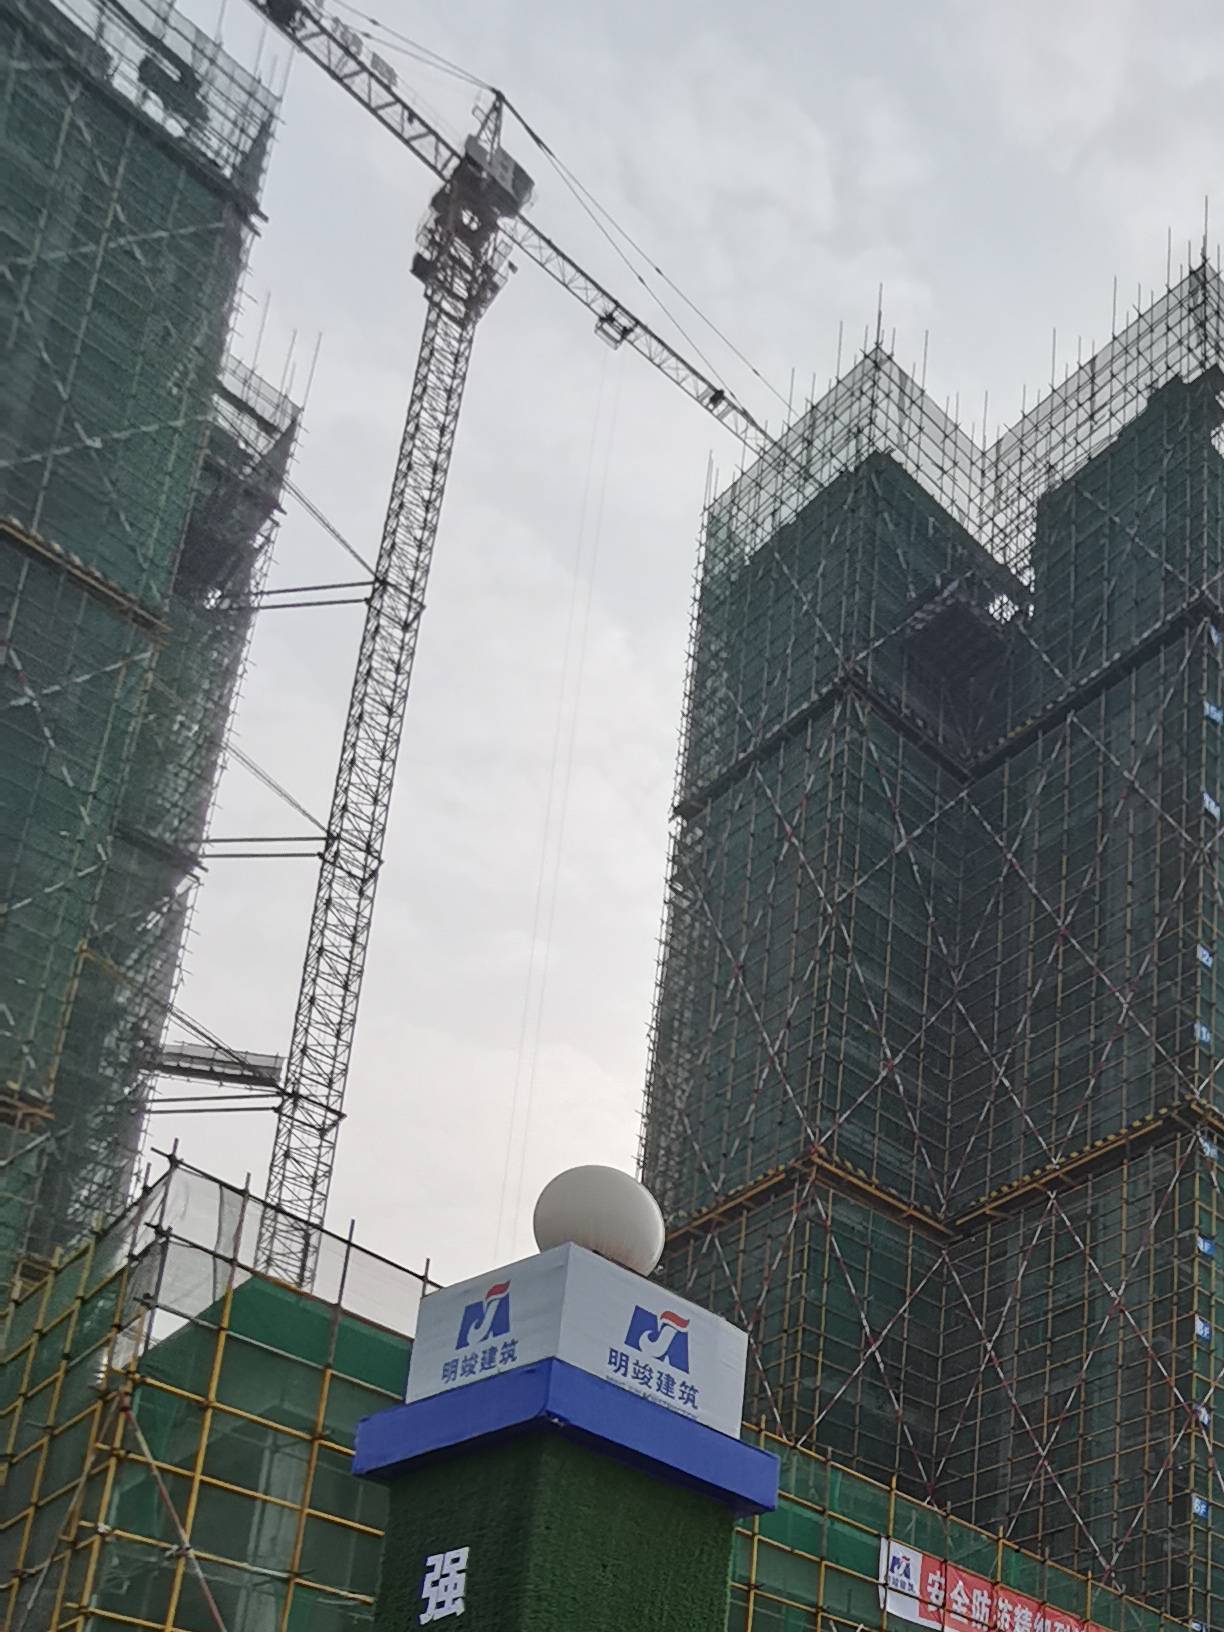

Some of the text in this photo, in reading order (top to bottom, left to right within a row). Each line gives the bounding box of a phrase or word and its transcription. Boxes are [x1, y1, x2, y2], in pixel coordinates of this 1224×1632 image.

[441, 1338, 519, 1385] 明竣建筑
[607, 1346, 700, 1410] 明竣建筑
